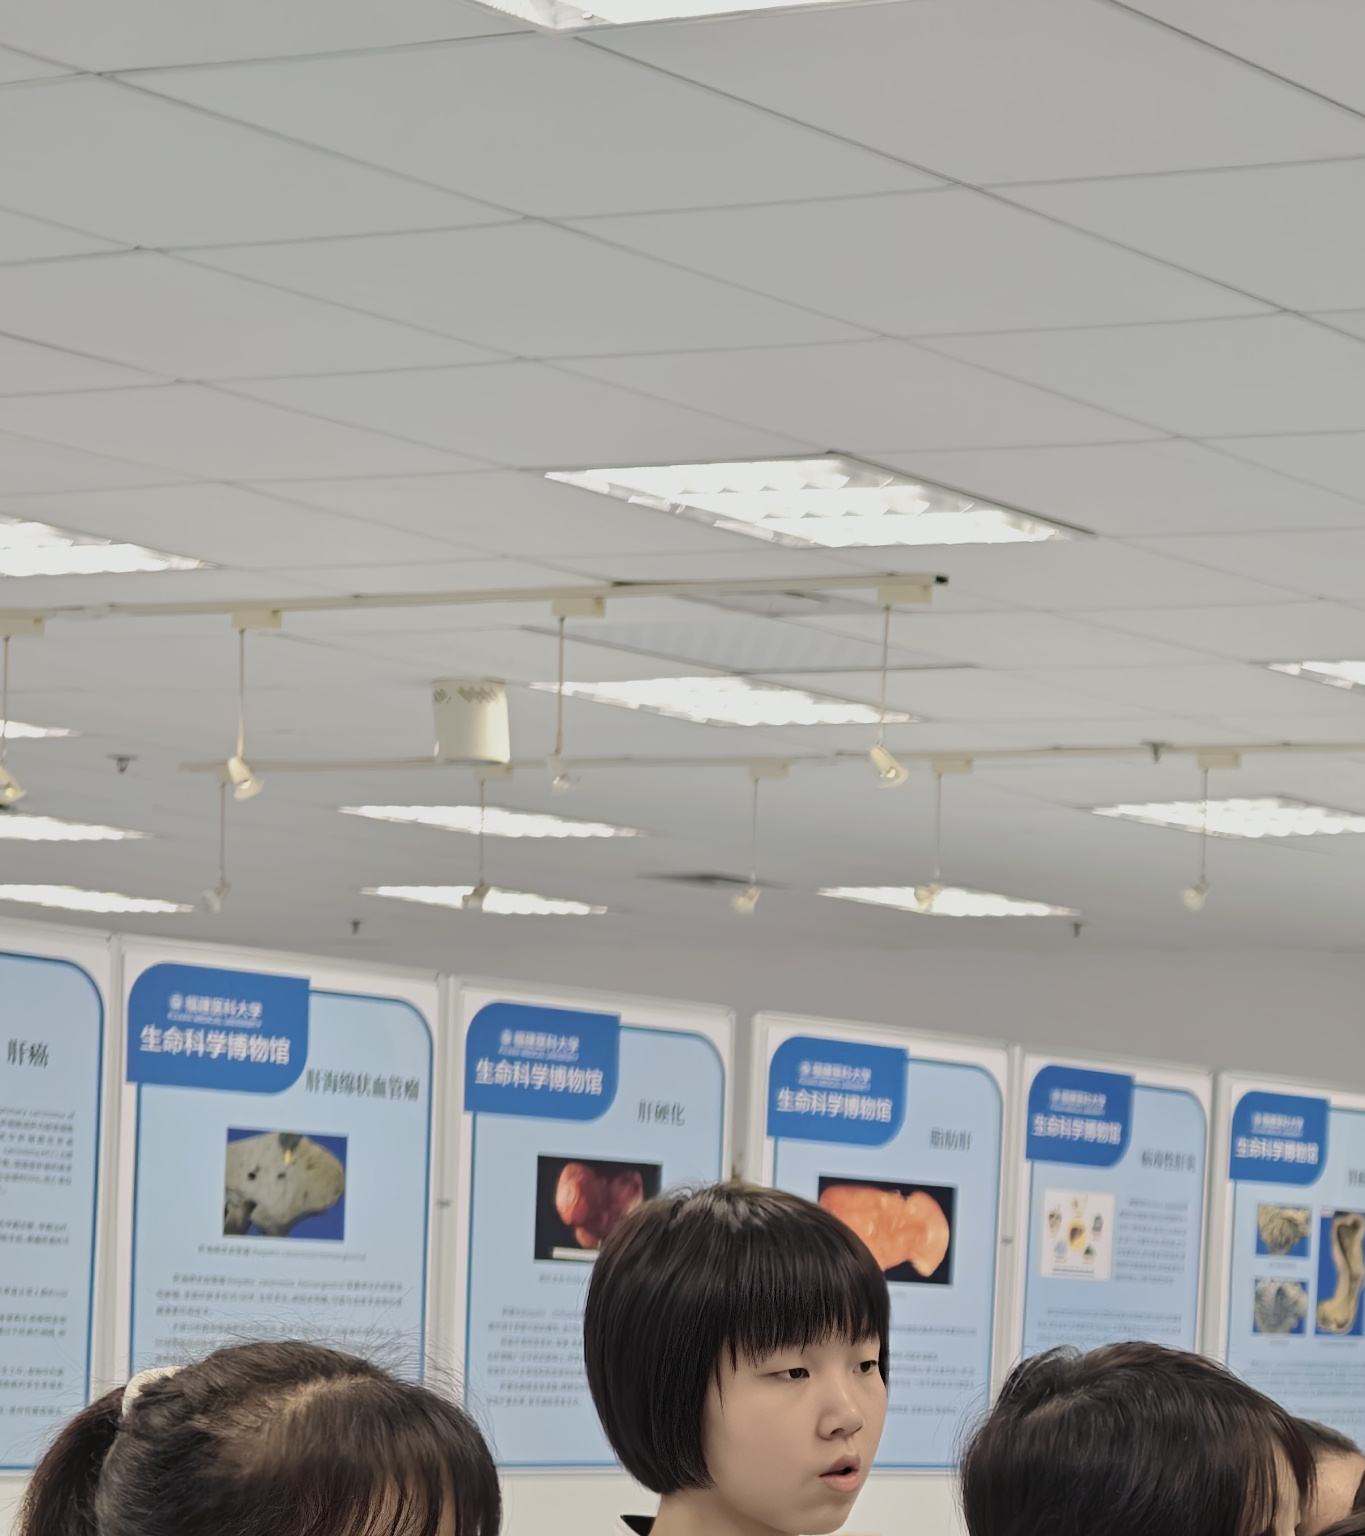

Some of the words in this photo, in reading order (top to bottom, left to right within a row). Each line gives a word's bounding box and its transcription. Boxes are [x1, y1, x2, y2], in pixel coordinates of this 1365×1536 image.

[7, 1039, 49, 1068] 肝癌
[139, 1024, 291, 1065] 生命科学博物馆
[305, 1067, 420, 1102] 肝海绵状血管瘤
[474, 1057, 603, 1096] 生命科学博物馆
[638, 1099, 685, 1126] 肝硬化
[776, 1087, 893, 1123] 生命科学博物馆
[1032, 1113, 1122, 1145] 生命科学博物馆
[1235, 1137, 1319, 1165] 生命科学博物馆
